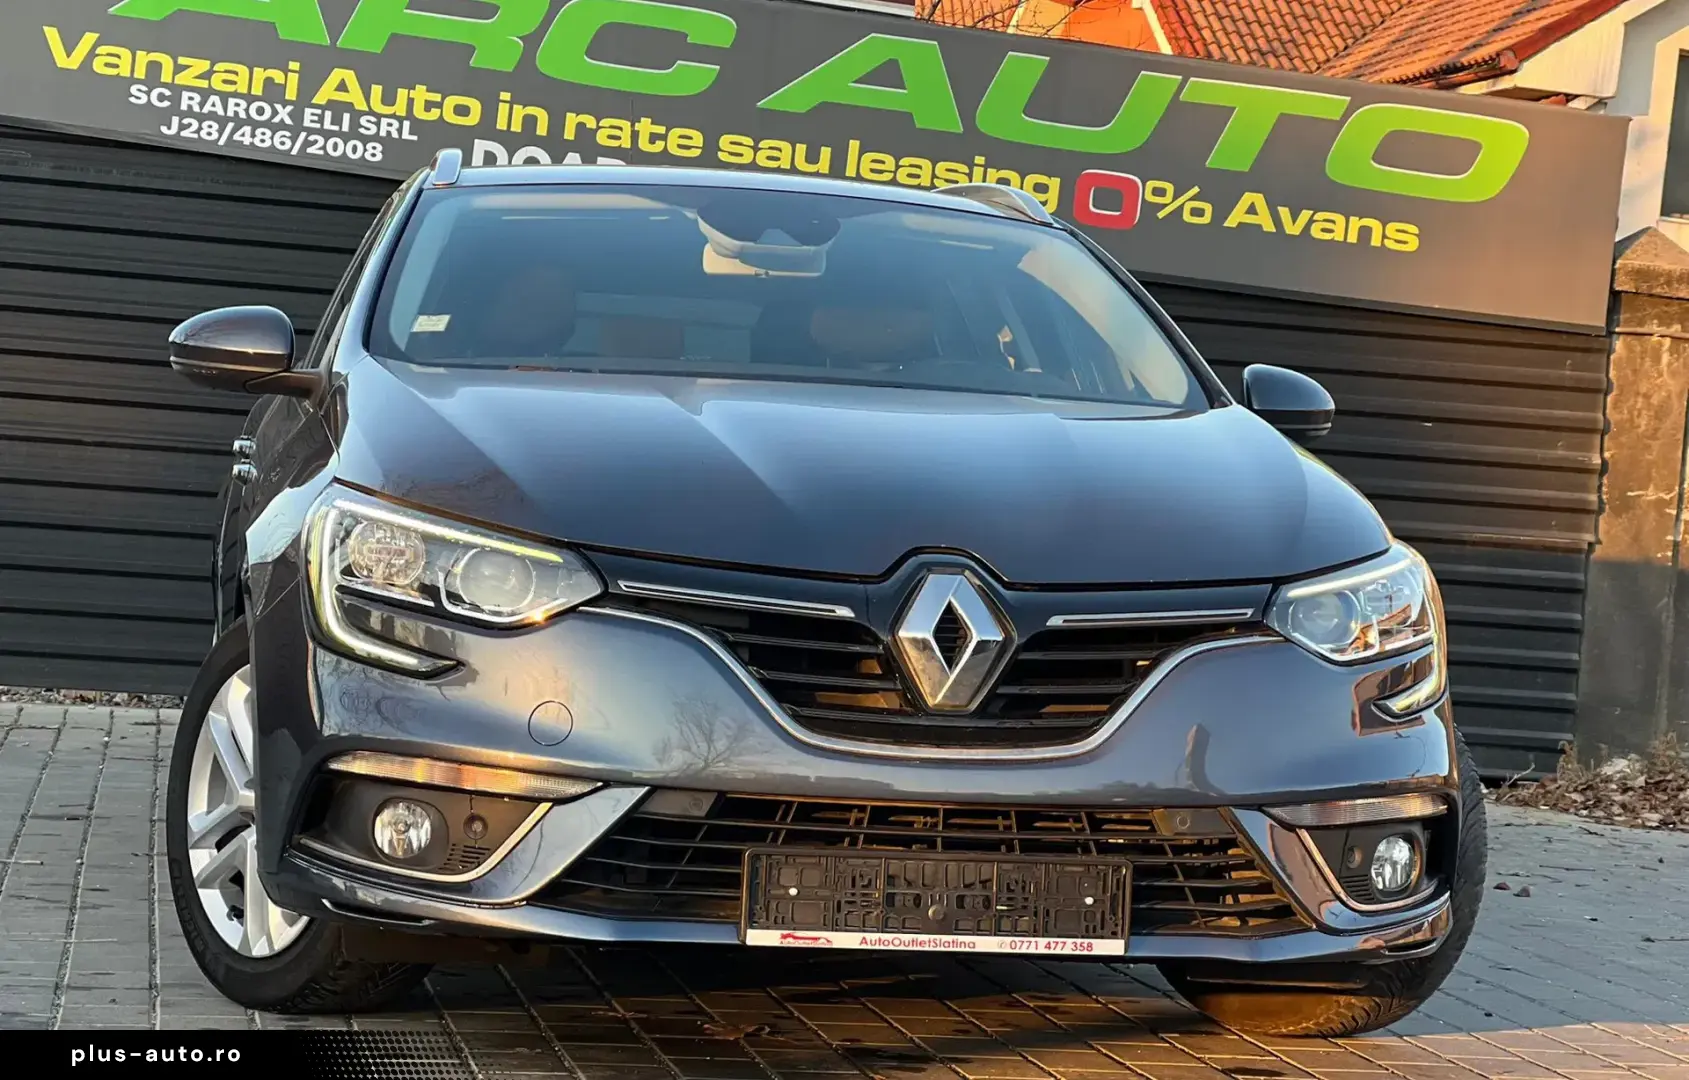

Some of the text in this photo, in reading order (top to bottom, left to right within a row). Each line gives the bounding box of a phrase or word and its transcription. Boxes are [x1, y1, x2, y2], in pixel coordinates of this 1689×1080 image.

[42, 25, 300, 101] Vanzari
[311, 67, 483, 127] Auto
[496, 91, 549, 137] in
[563, 111, 704, 158] rate
[717, 133, 832, 174] sau
[845, 139, 1061, 214] leasing
[1223, 191, 1420, 252] Avans
[128, 84, 418, 141] SC RAROX ELI SRL
[160, 115, 384, 162] J28/486/2008
[757, 32, 1529, 203] AUTO
[859, 935, 976, 950] AutoOutletSlatina
[1009, 939, 1094, 953] 0771 477 358
